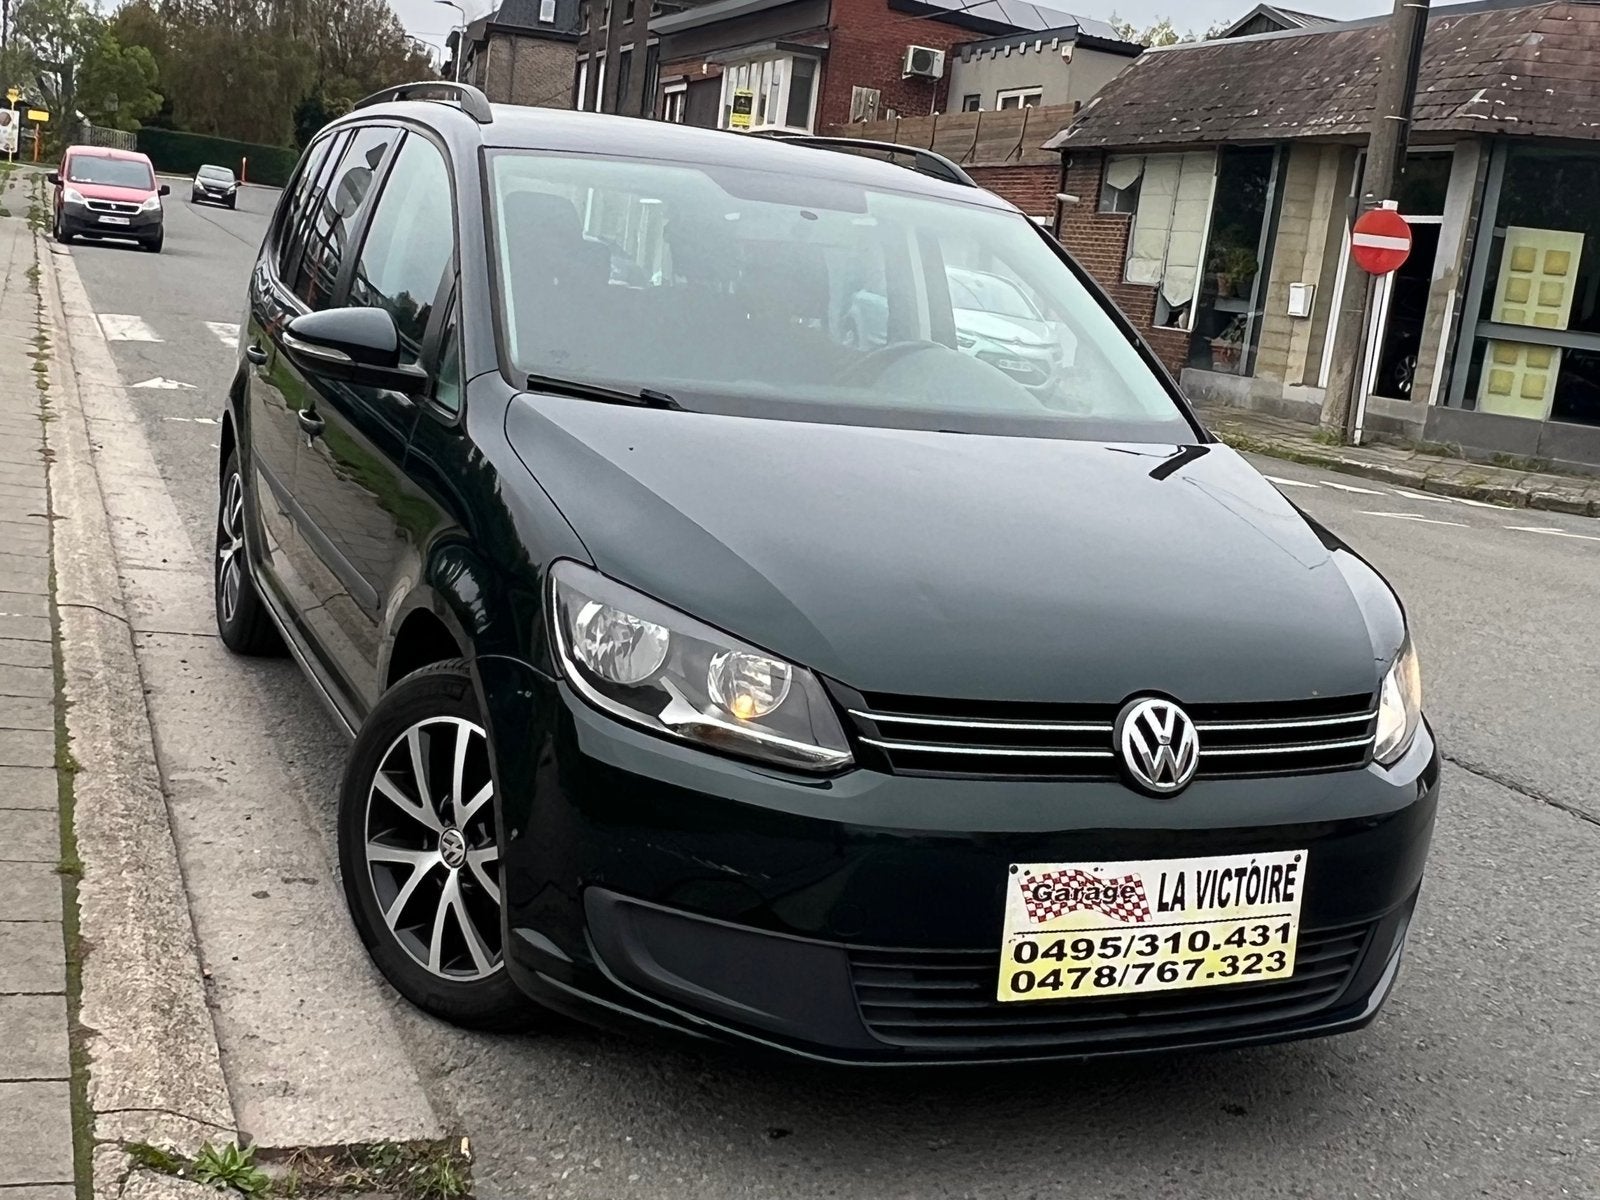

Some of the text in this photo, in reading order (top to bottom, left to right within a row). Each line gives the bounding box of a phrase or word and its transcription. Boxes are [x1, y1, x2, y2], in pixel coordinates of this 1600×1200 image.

[1033, 880, 1136, 904] Garage
[1157, 862, 1298, 913] LA VICTOIRE
[1013, 922, 1291, 964] 0495/310.431
[1010, 950, 1287, 994] 0478/767.323
